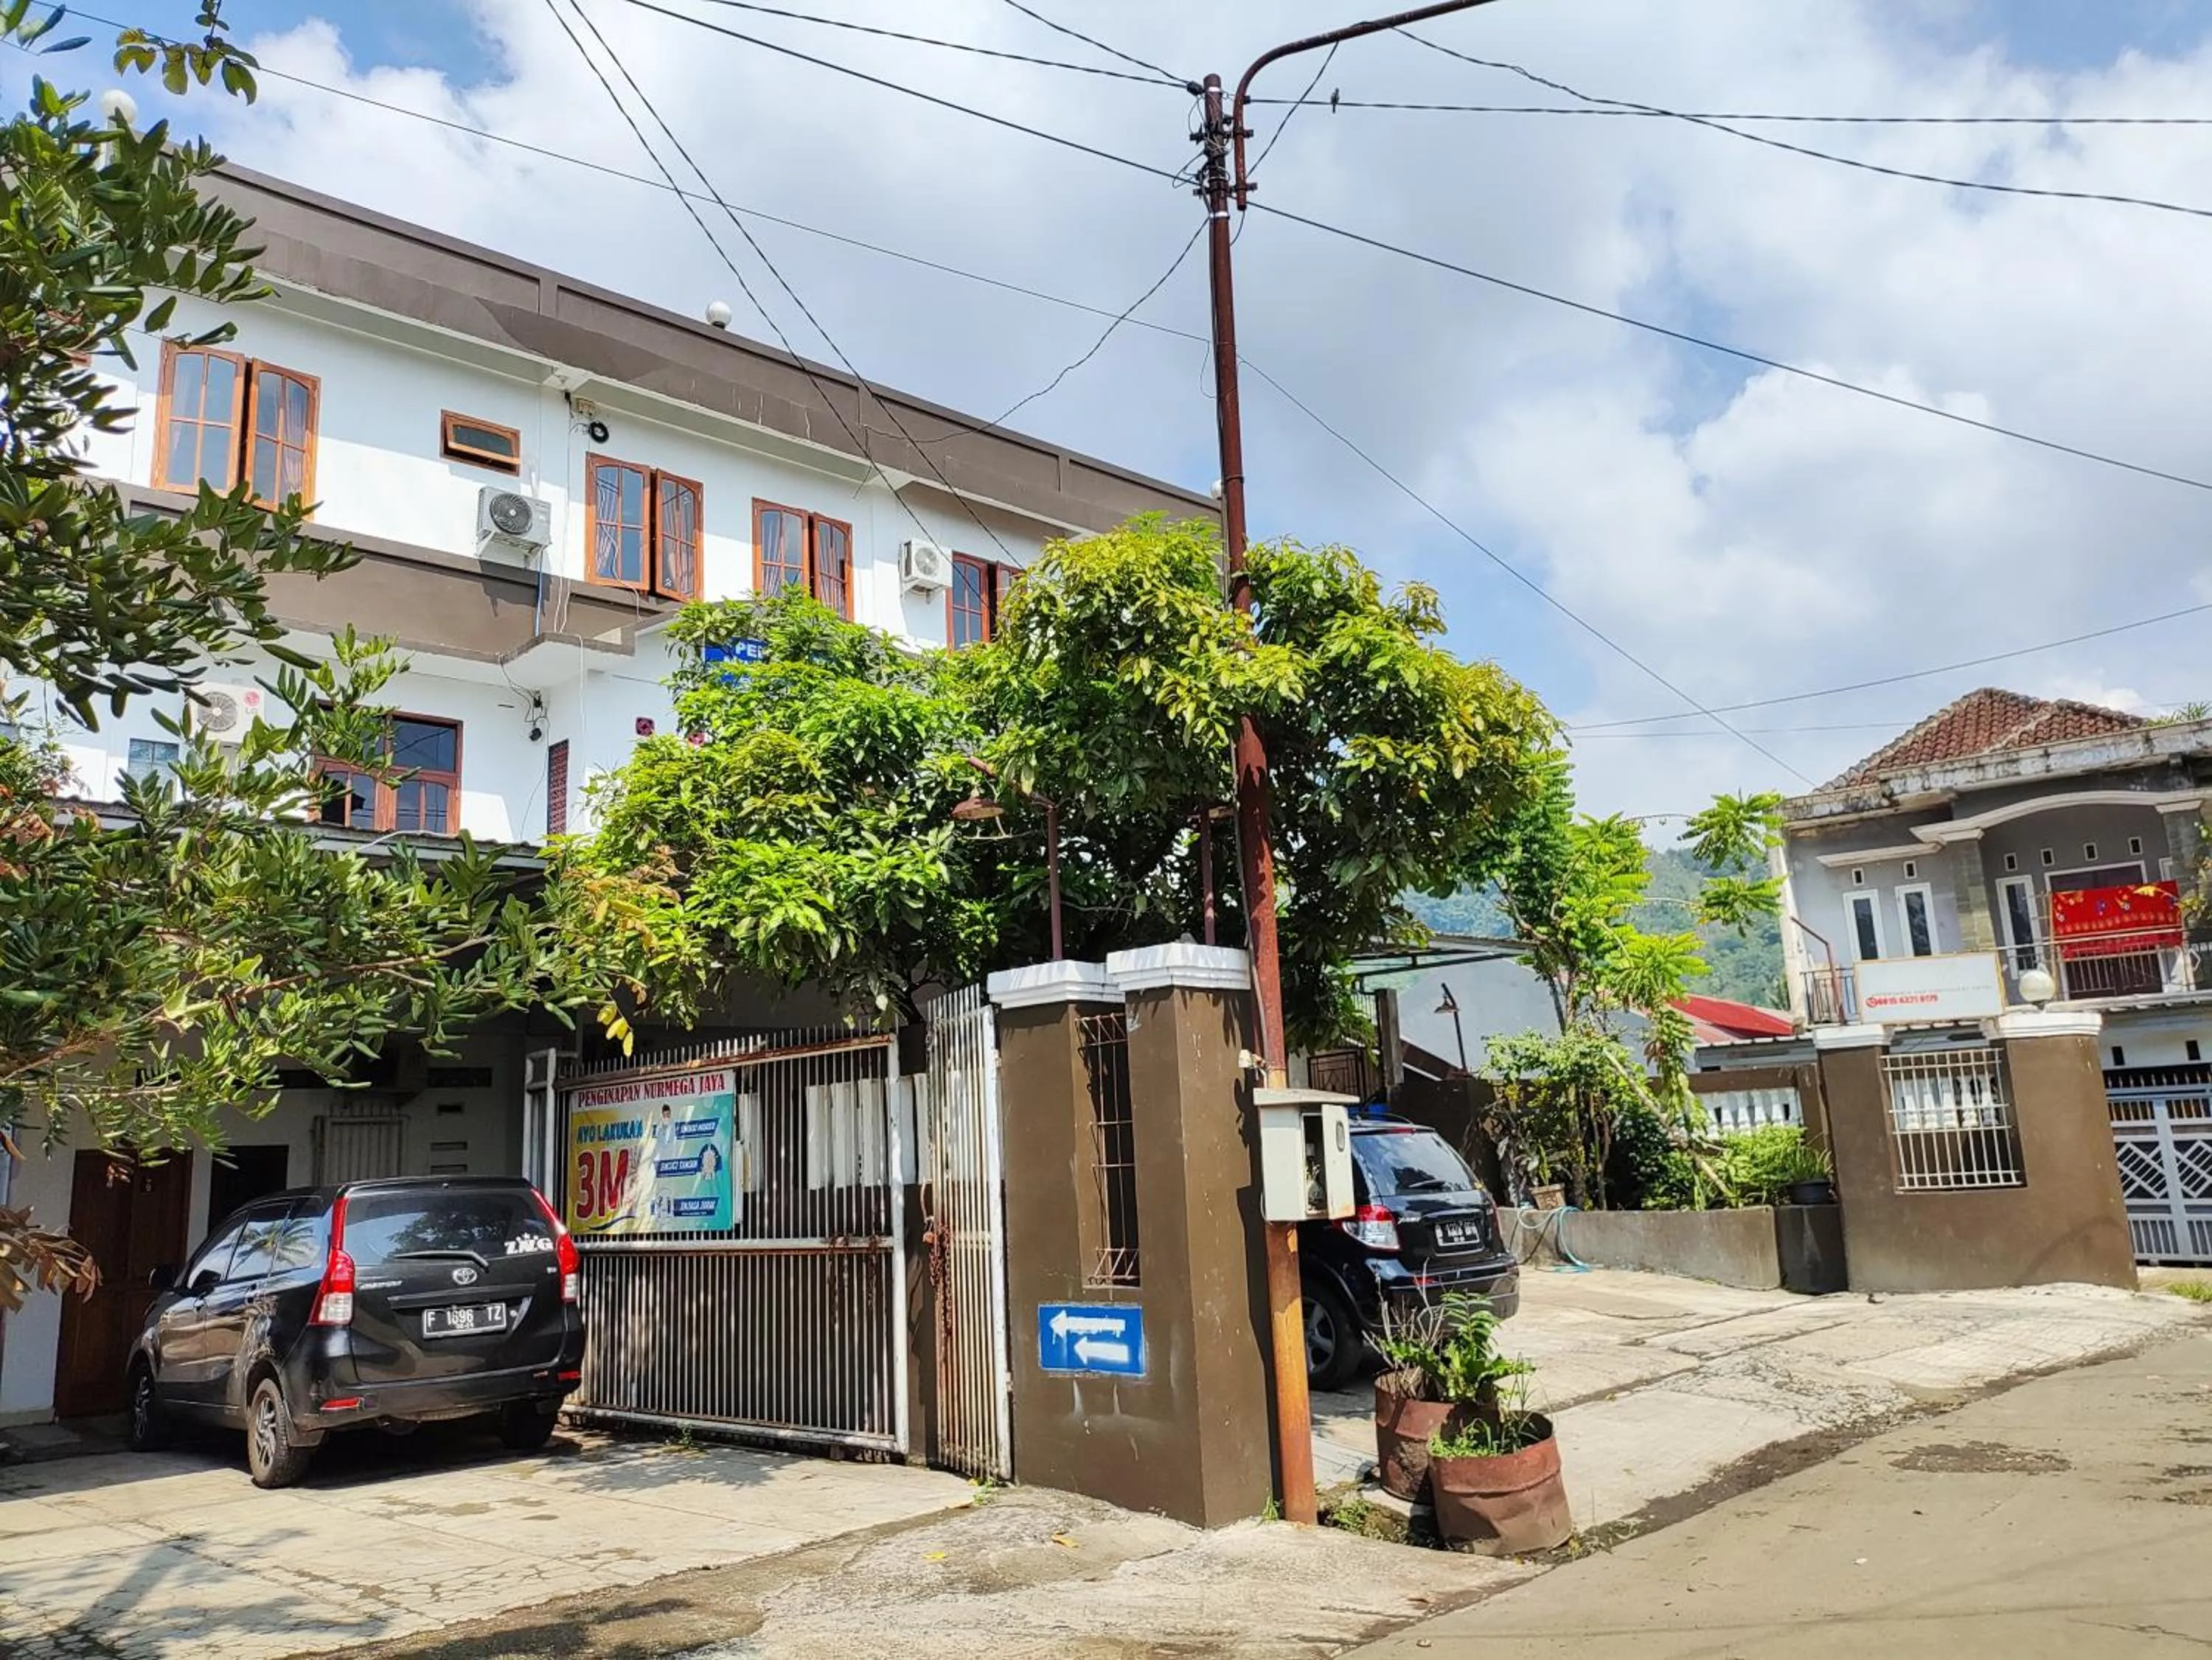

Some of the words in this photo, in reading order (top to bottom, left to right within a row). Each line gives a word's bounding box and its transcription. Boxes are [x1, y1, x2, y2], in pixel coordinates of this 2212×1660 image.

[577, 1084, 641, 1107] PENGINAPAN
[644, 1077, 695, 1099] NURMEGA
[698, 1073, 725, 1095] JAYA
[577, 1125, 596, 1144] AYO
[575, 1148, 631, 1220] 3M
[428, 1311, 436, 1328] F
[487, 1305, 502, 1322] TZ
